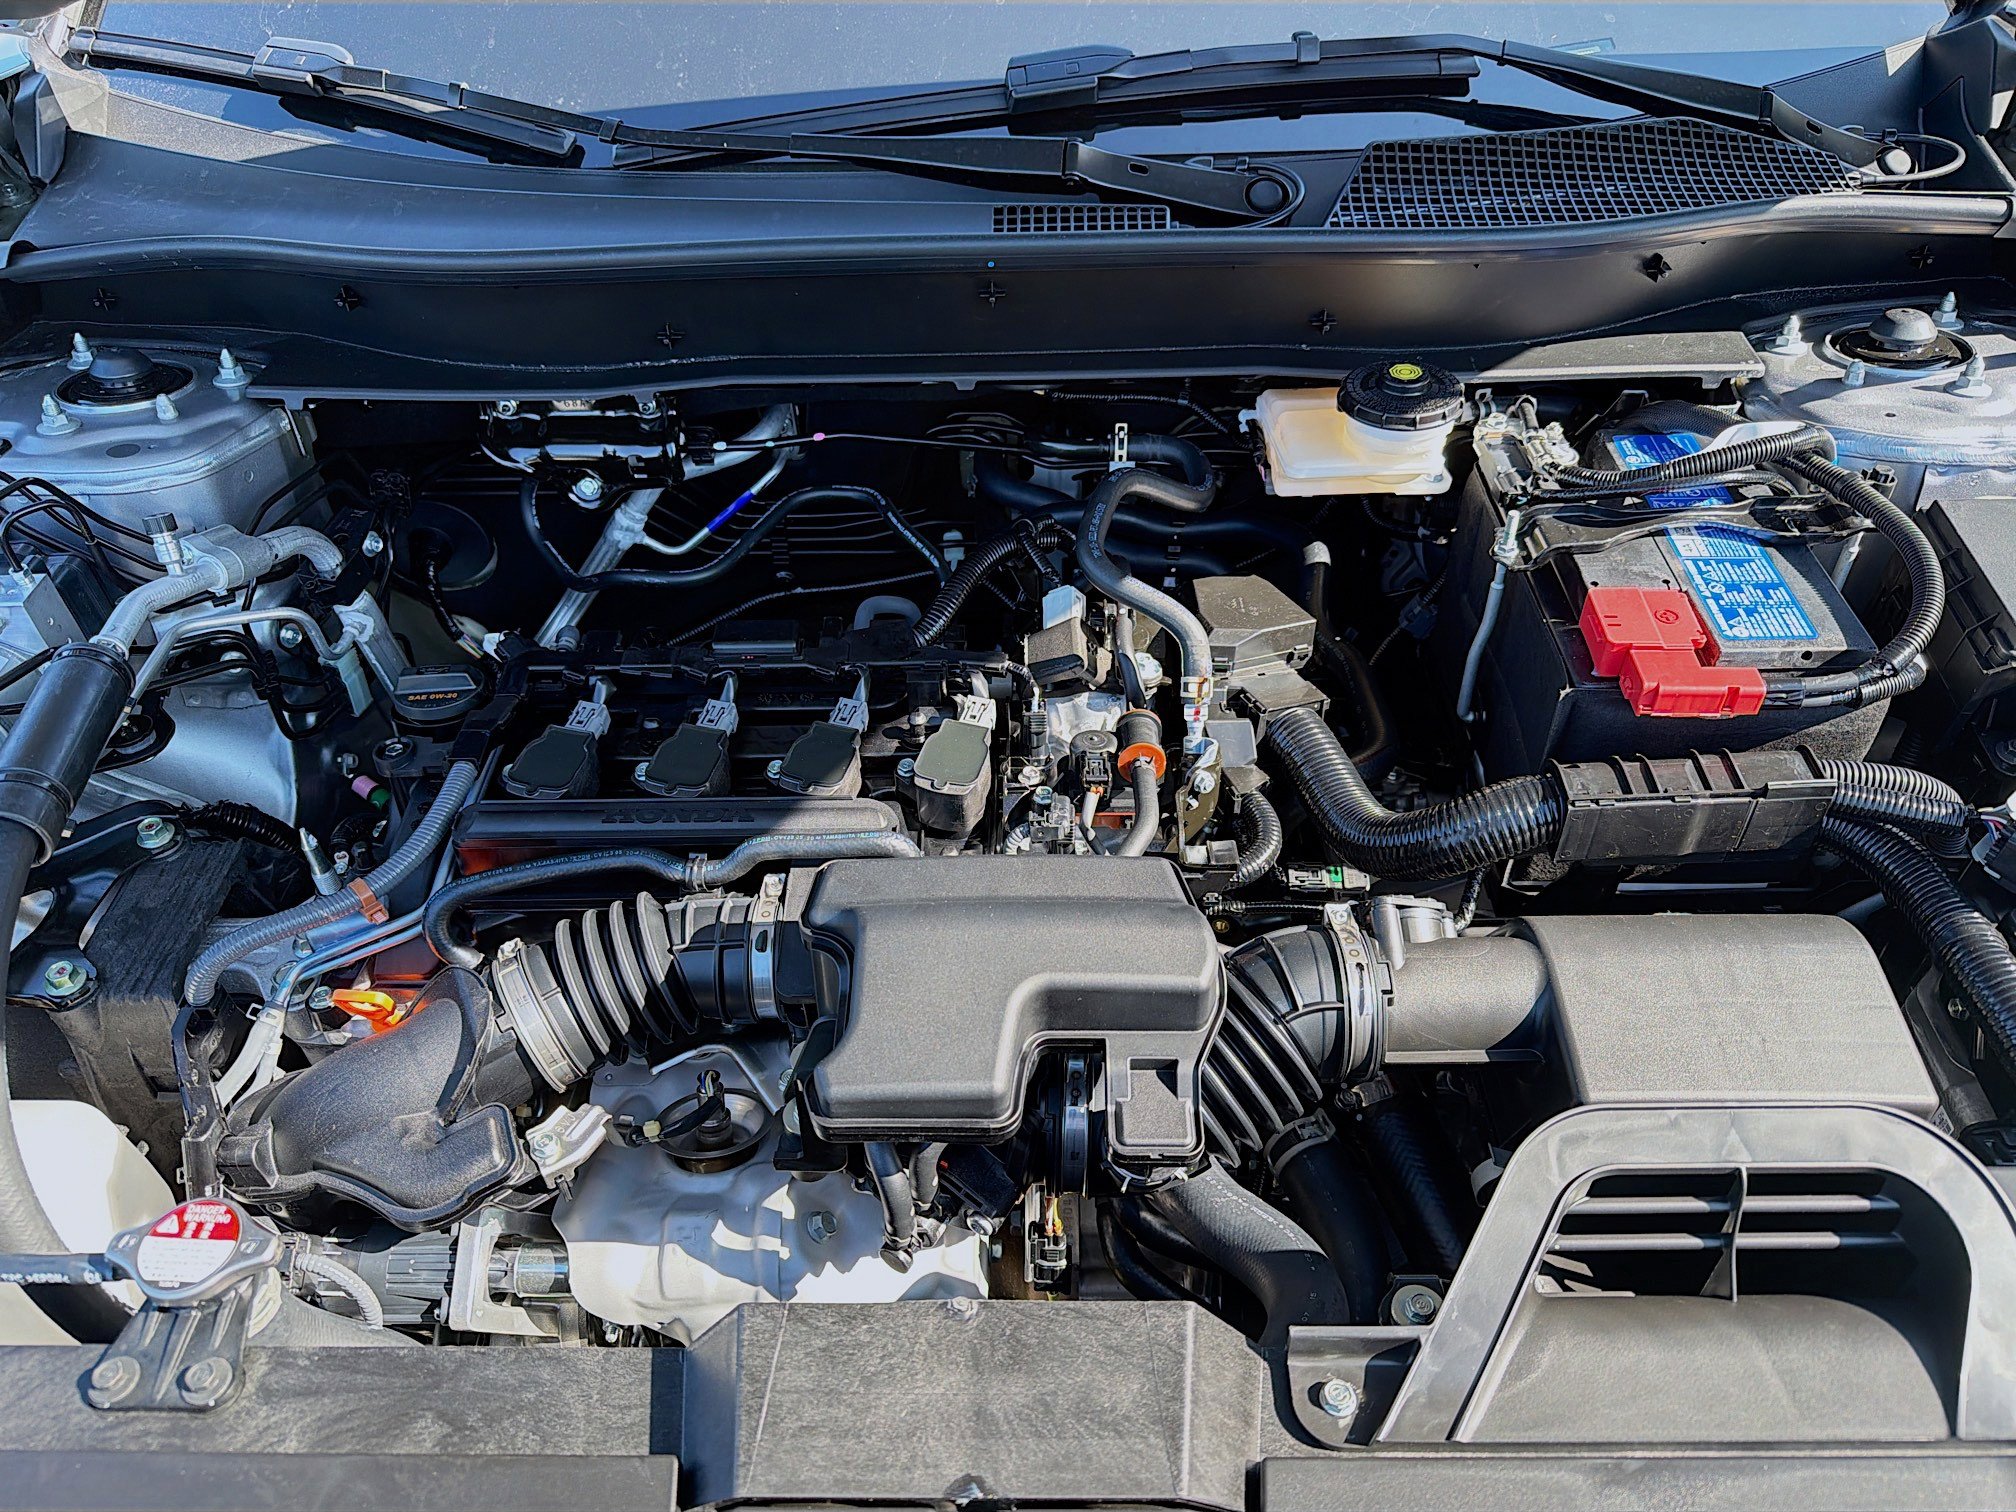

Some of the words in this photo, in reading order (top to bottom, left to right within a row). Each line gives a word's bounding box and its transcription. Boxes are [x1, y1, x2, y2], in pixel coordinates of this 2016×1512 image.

[429, 692, 458, 700] 0W-20
[601, 808, 755, 824] HONDA
[187, 1203, 228, 1215] DANGER
